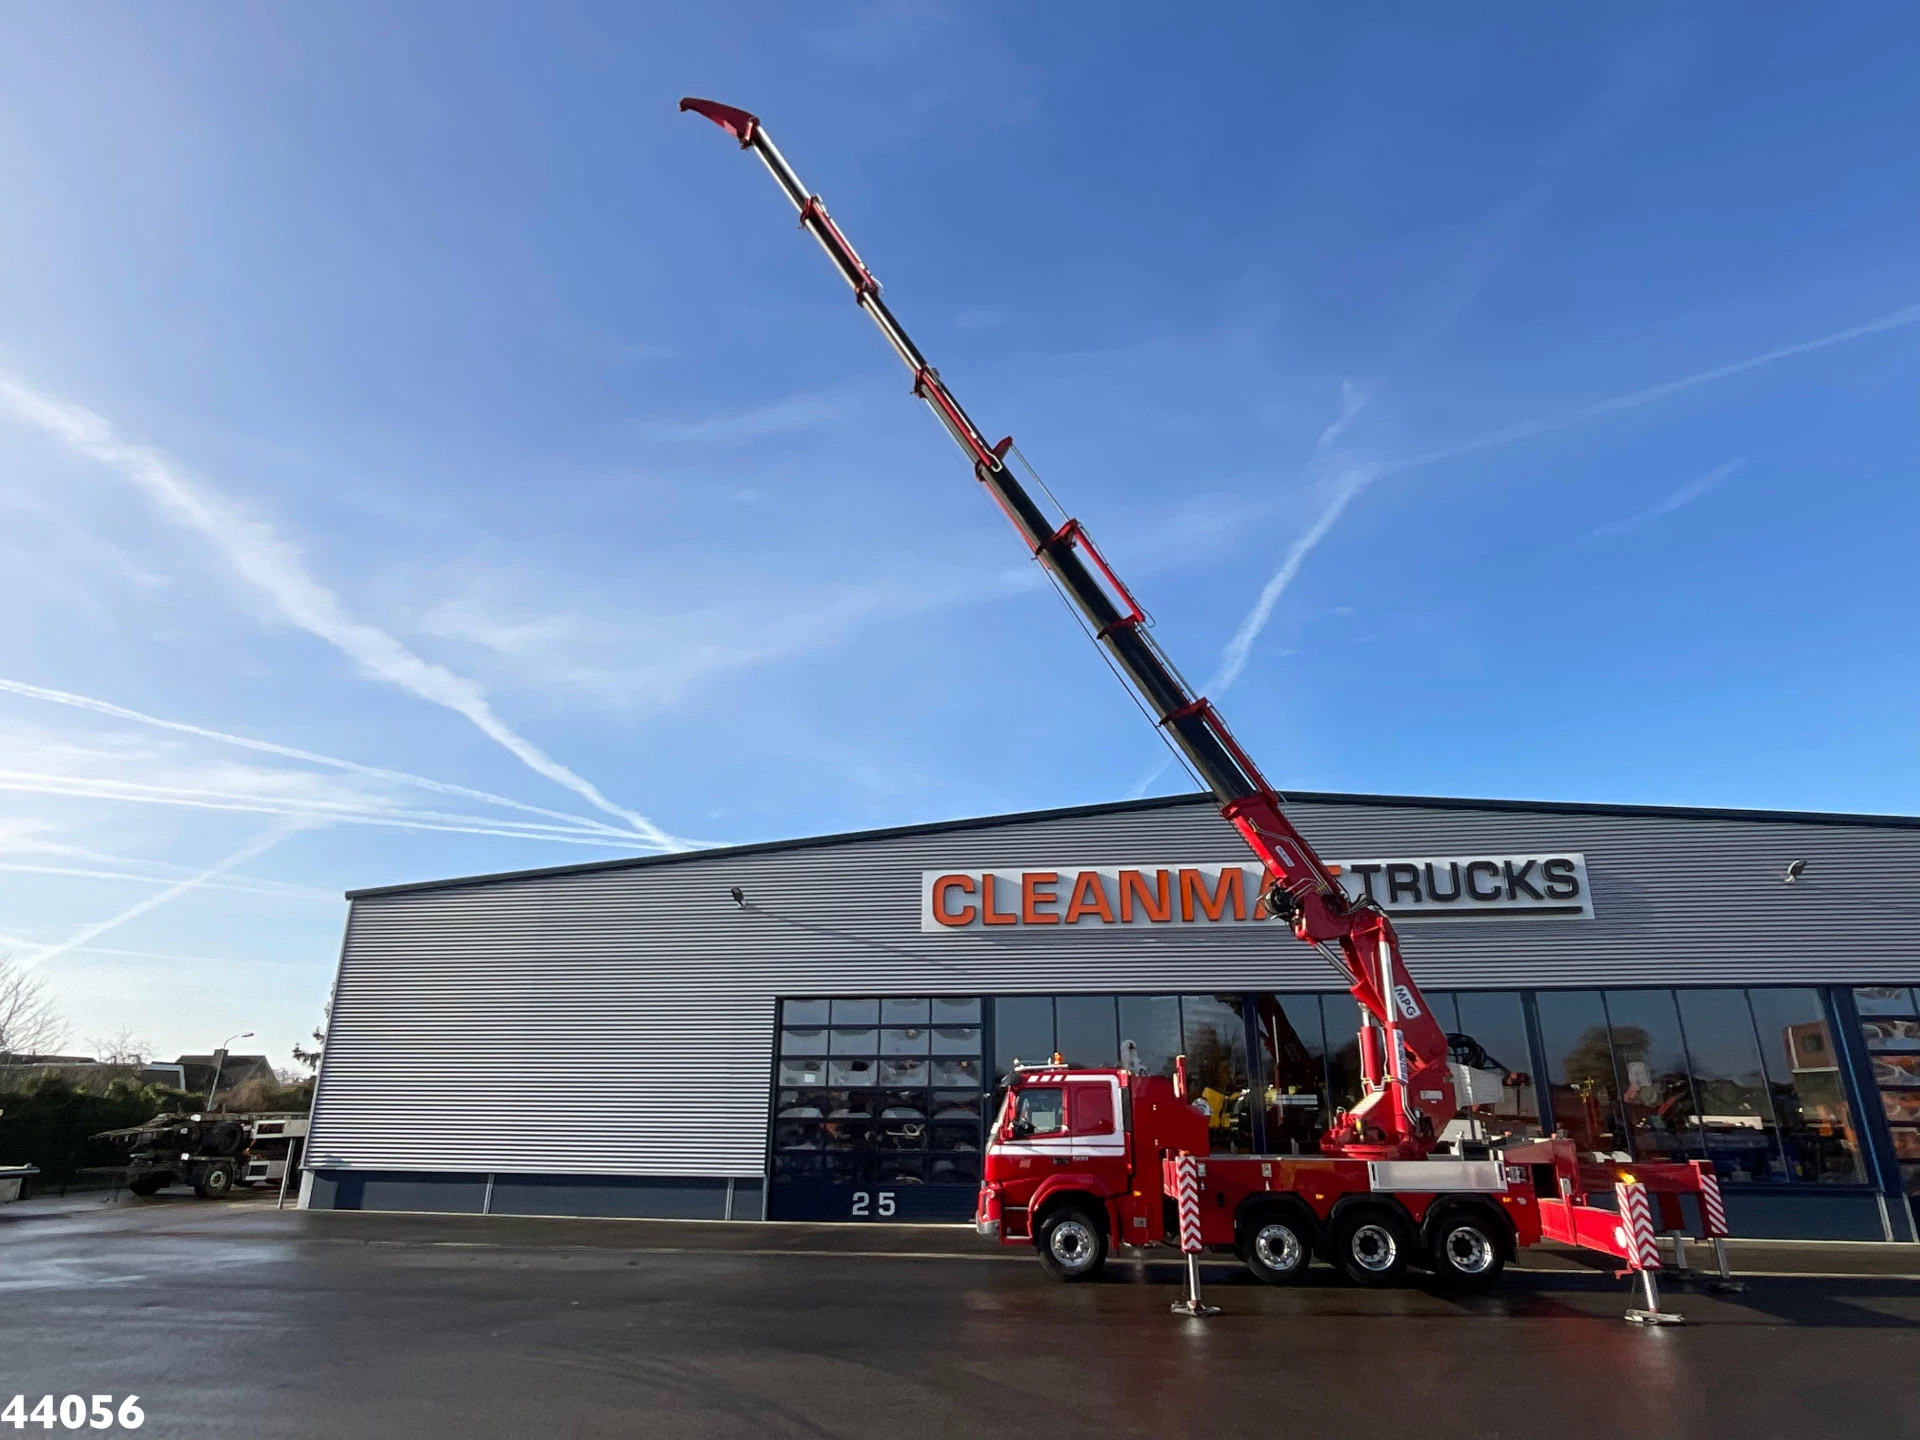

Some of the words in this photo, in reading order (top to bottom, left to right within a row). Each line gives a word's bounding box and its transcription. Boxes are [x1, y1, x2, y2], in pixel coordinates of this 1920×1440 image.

[932, 864, 1341, 927] CLEANM
[1350, 858, 1580, 904] TRUCKS
[1394, 988, 1417, 1016] MPG
[852, 1191, 896, 1216] 25
